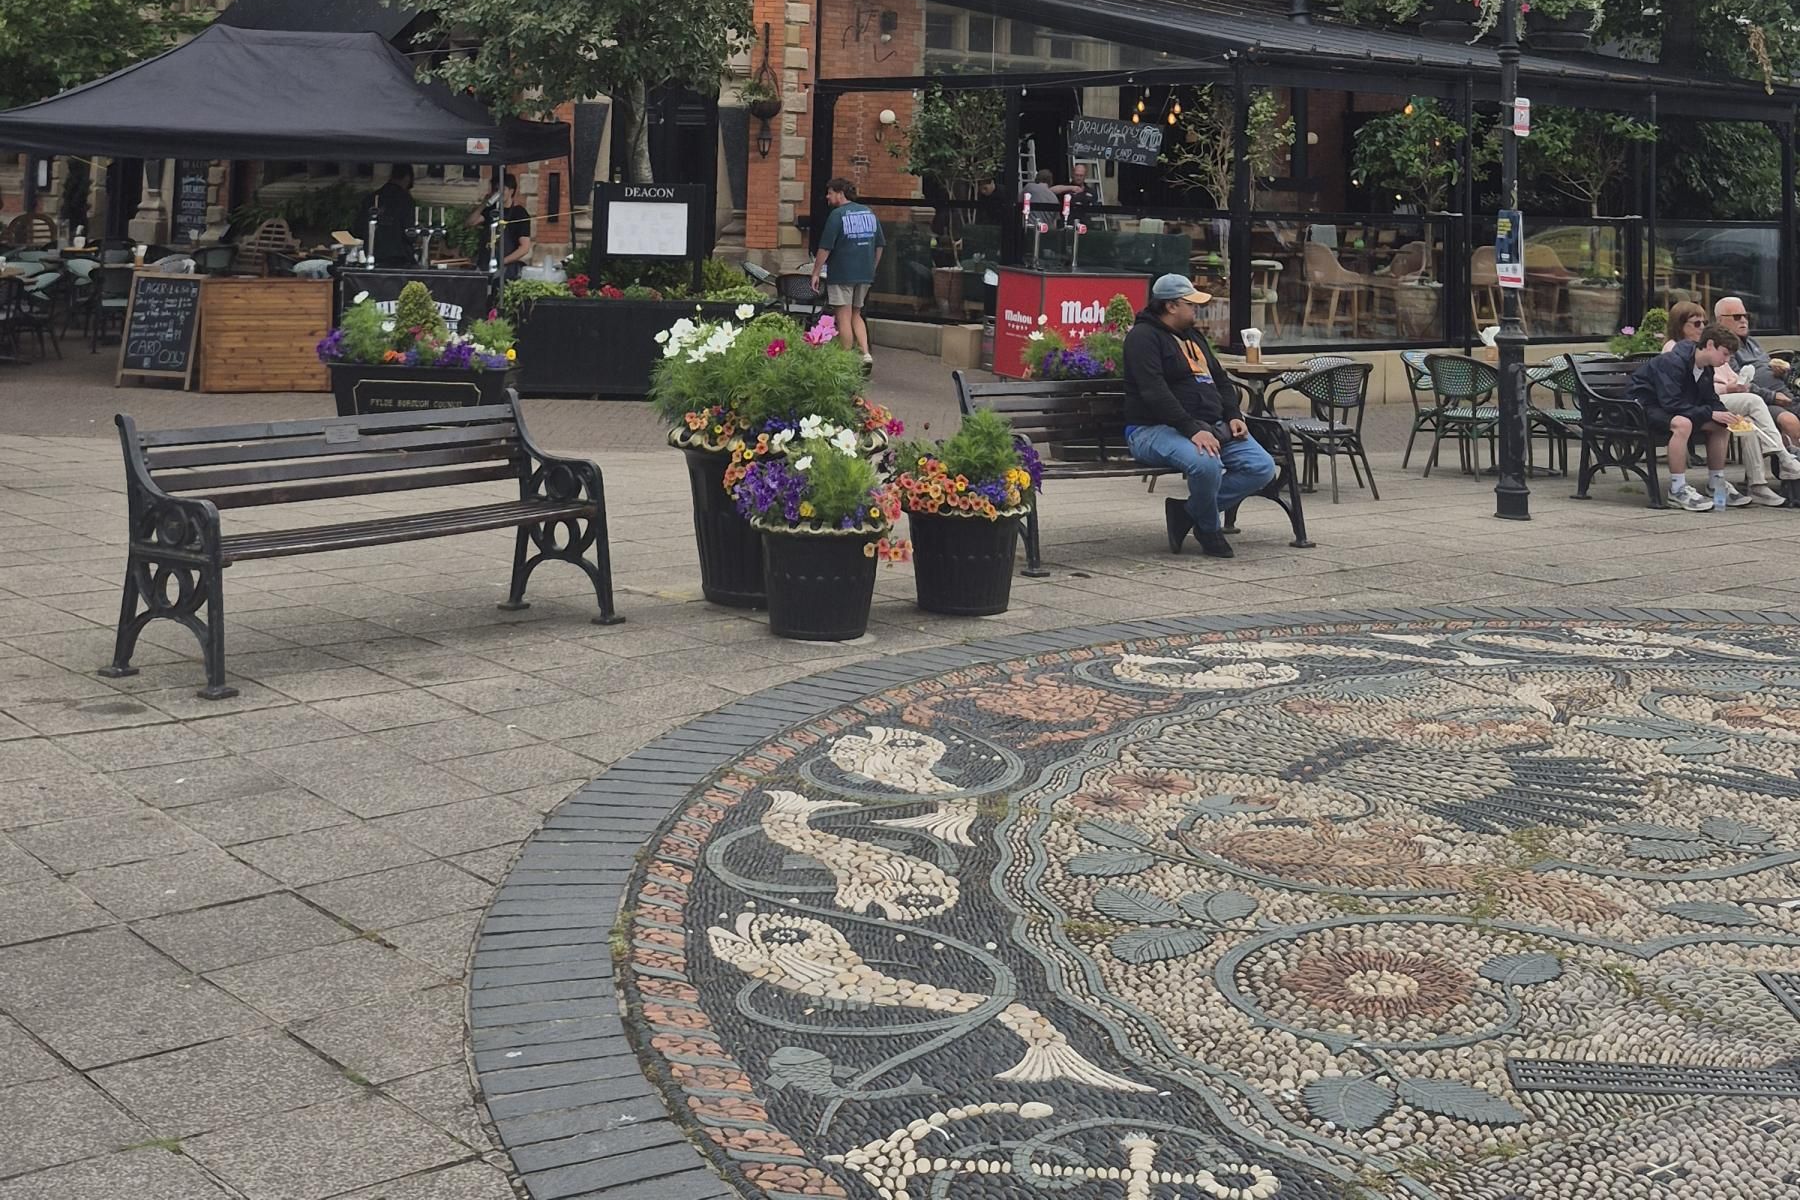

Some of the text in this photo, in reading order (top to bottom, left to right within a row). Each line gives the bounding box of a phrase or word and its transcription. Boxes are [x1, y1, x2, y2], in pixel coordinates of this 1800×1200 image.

[624, 187, 675, 198] DEACON
[1005, 309, 1032, 325] Mahou
[1061, 300, 1105, 324] Mah
